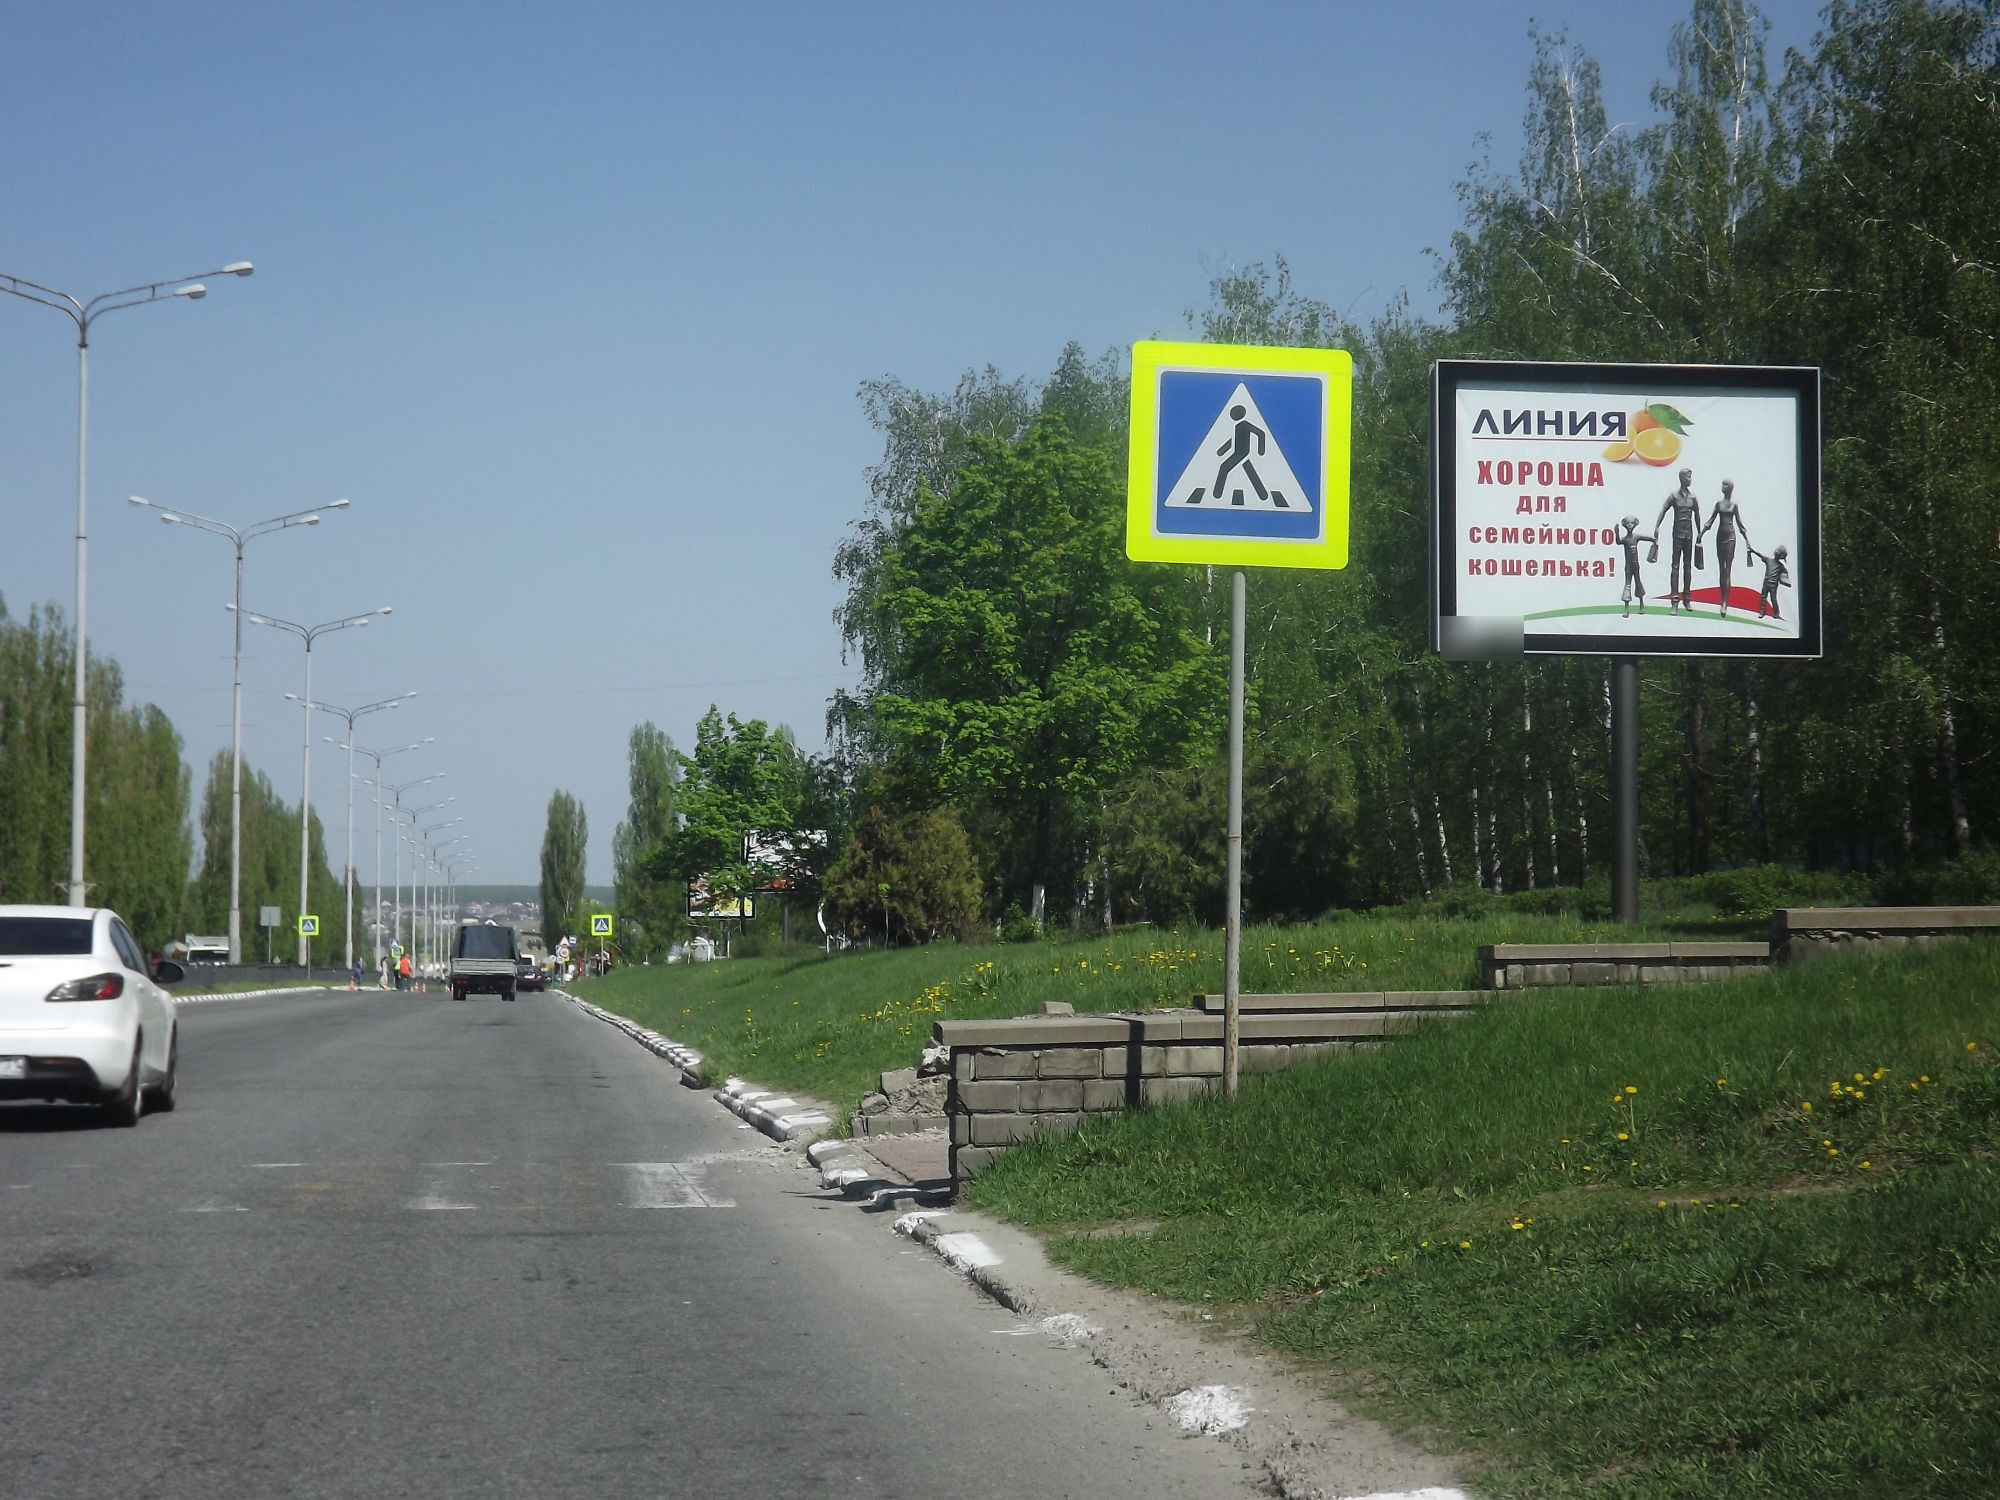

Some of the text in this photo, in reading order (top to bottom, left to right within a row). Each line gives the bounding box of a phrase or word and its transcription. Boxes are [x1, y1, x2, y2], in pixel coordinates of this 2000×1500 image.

[1472, 409, 1627, 437] ЛИНИЯ
[1477, 460, 1604, 486] ХОРОША
[1516, 495, 1567, 515] для
[1469, 523, 1615, 545] семейного
[1468, 557, 1616, 577] кошелька!
